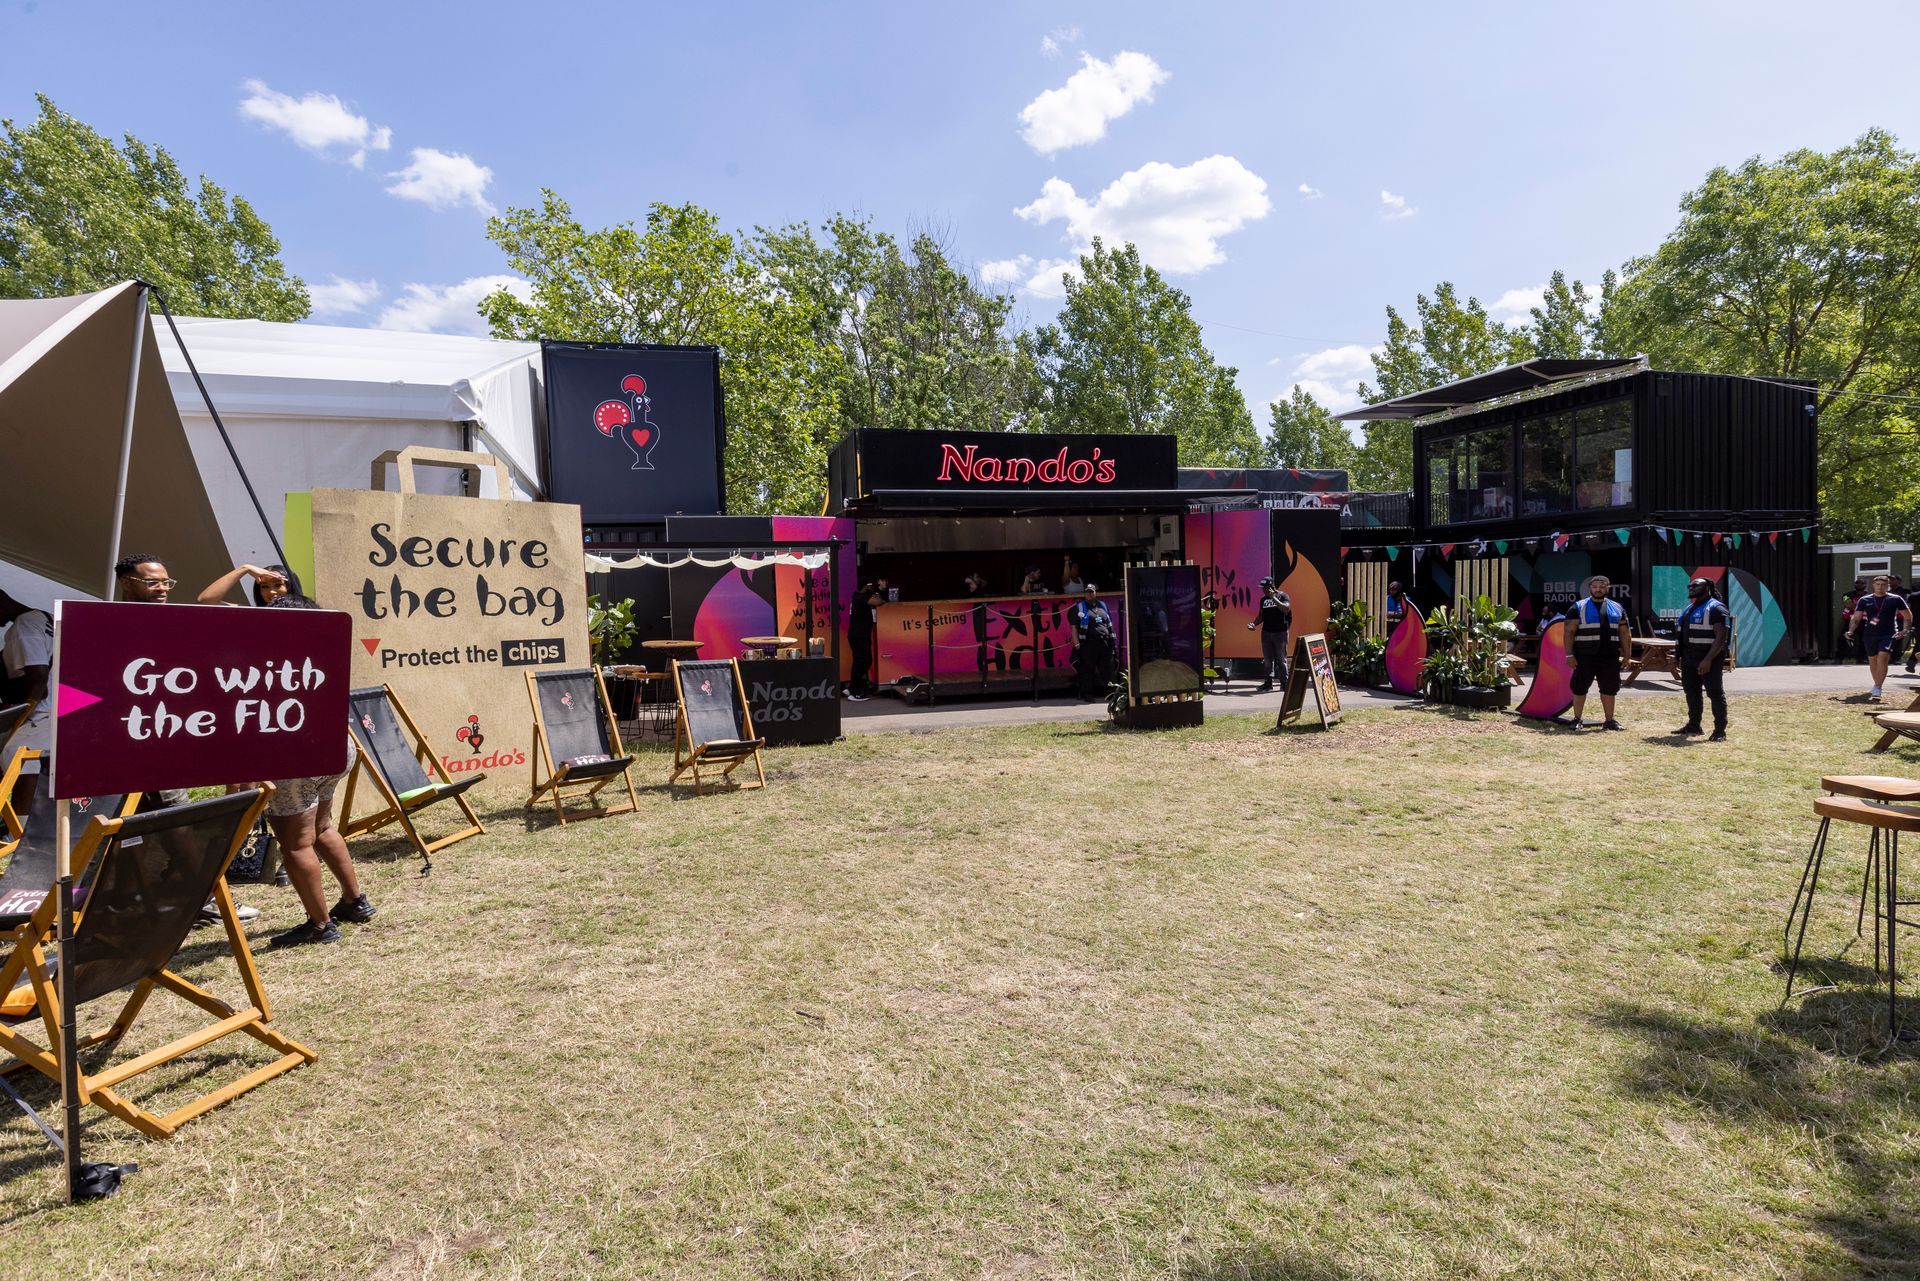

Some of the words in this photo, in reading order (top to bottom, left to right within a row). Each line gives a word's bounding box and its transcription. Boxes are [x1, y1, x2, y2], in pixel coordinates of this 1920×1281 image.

[937, 444, 1116, 483] Nando's
[368, 523, 549, 568] Secure
[1202, 565, 1235, 588] Fly
[1543, 582, 1576, 593] BBC
[354, 573, 457, 619] the
[476, 573, 565, 626] bag
[1543, 593, 1577, 603] RADIO
[1611, 584, 1631, 598] TR
[902, 618, 922, 631] It's
[925, 613, 967, 629] getting
[972, 601, 1068, 643] Extr
[381, 646, 460, 668] Protect
[466, 645, 498, 664] the
[508, 642, 560, 664] chips
[123, 657, 198, 695] Go
[214, 656, 326, 693] with
[120, 701, 216, 740] the
[235, 698, 305, 734] FLO
[0, 897, 42, 914] HO
